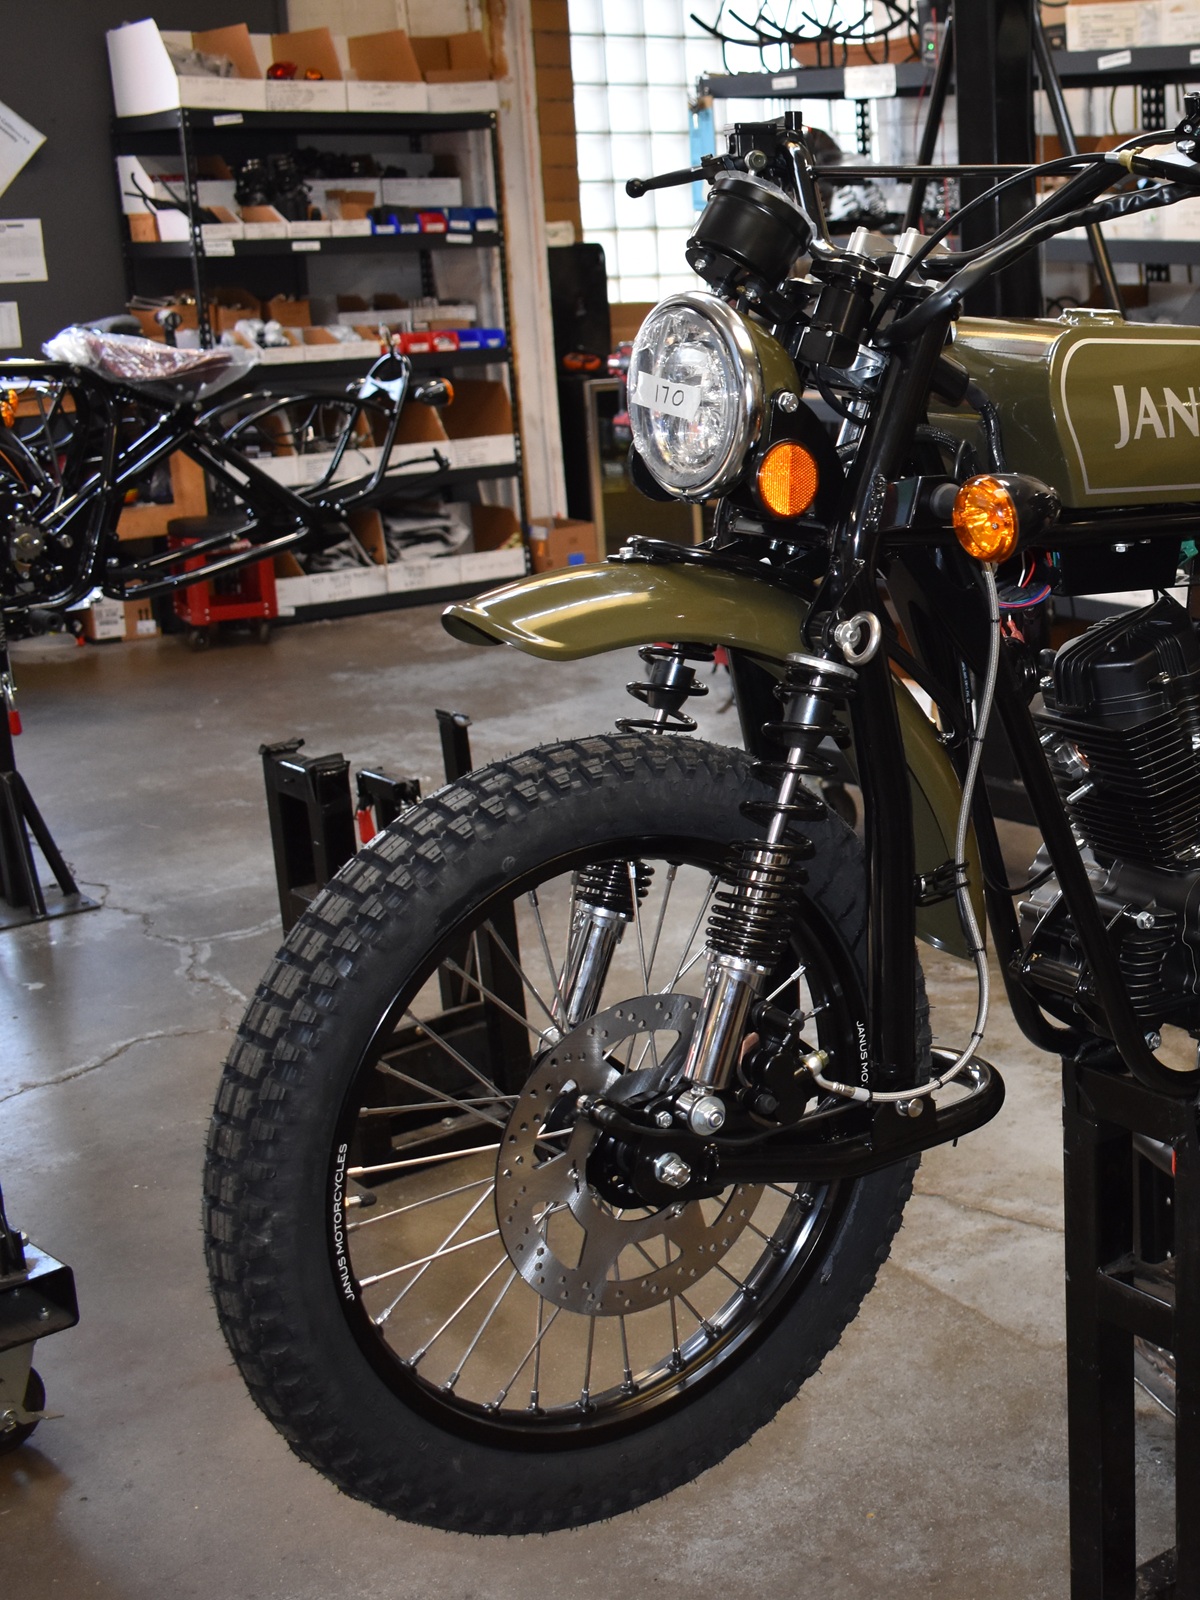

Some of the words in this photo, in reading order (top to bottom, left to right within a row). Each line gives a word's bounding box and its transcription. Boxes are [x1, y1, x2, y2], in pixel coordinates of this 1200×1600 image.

[655, 384, 685, 407] 170
[856, 1020, 868, 1060] JANUS
[333, 1143, 348, 1255] MOTORCYCLES
[337, 1257, 356, 1301] JANUS
